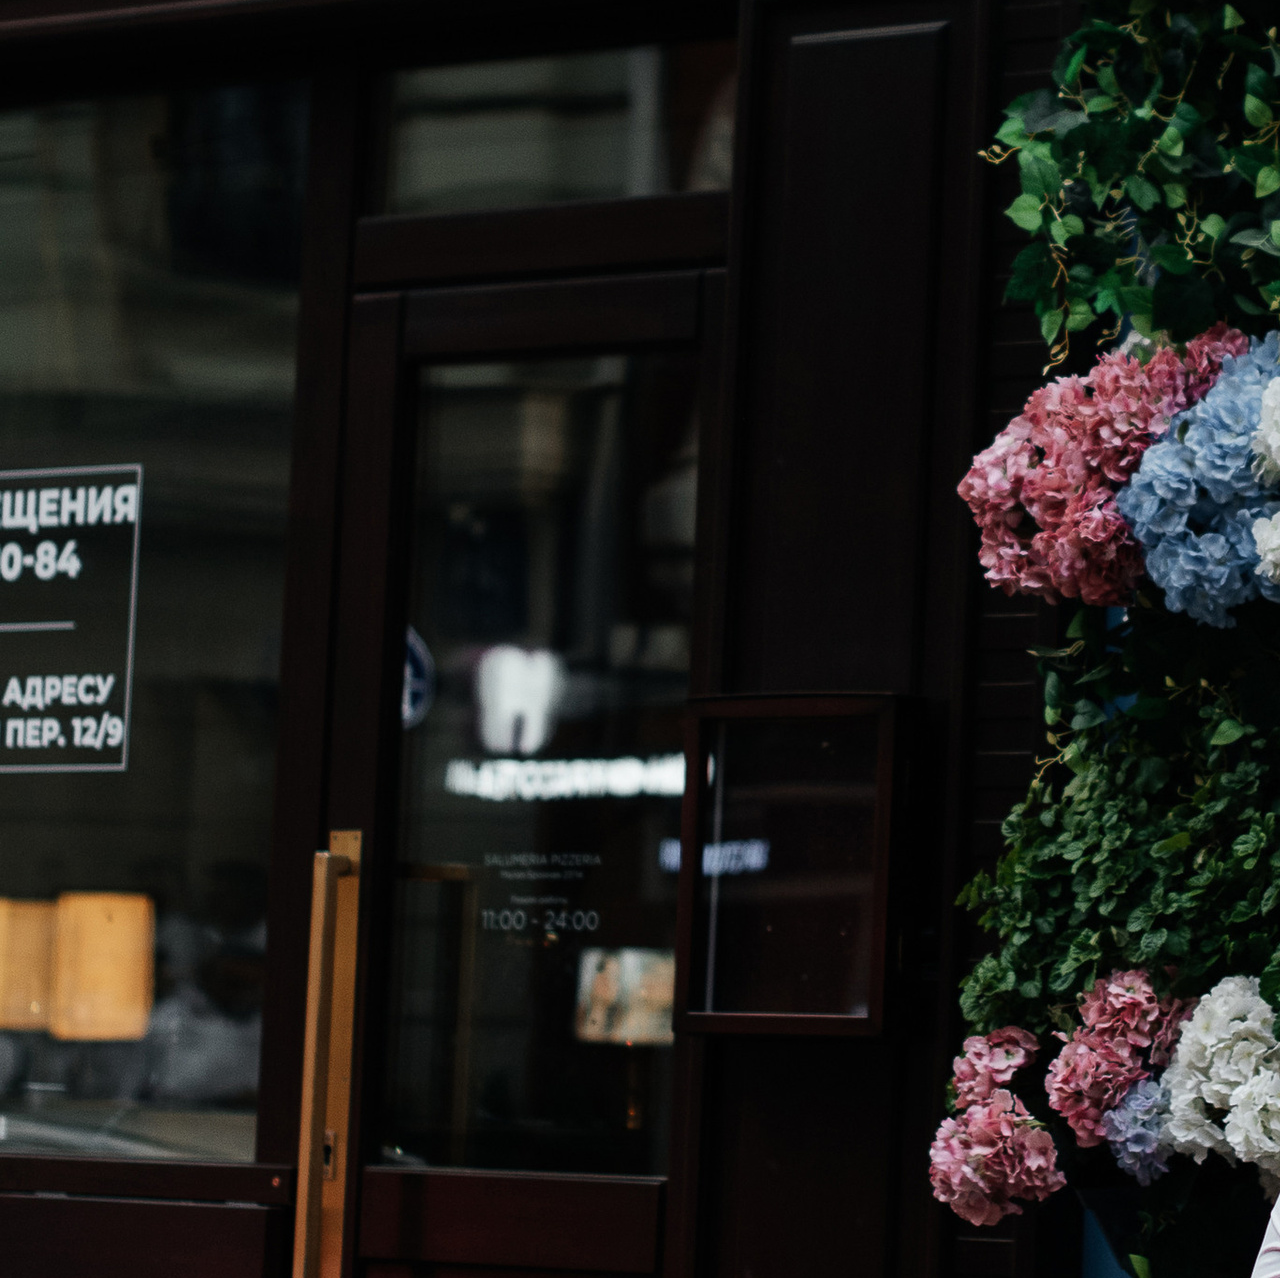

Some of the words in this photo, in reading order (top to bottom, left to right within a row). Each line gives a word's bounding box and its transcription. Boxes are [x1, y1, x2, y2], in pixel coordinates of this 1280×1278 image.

[0, 484, 138, 533] ЩЕНИЯ
[3, 674, 115, 710] АДРЕСУ
[5, 718, 66, 748] ПЕР.
[72, 711, 123, 749] 12/9
[550, 853, 602, 865] PIZZERIA
[544, 910, 600, 930] 24:00
